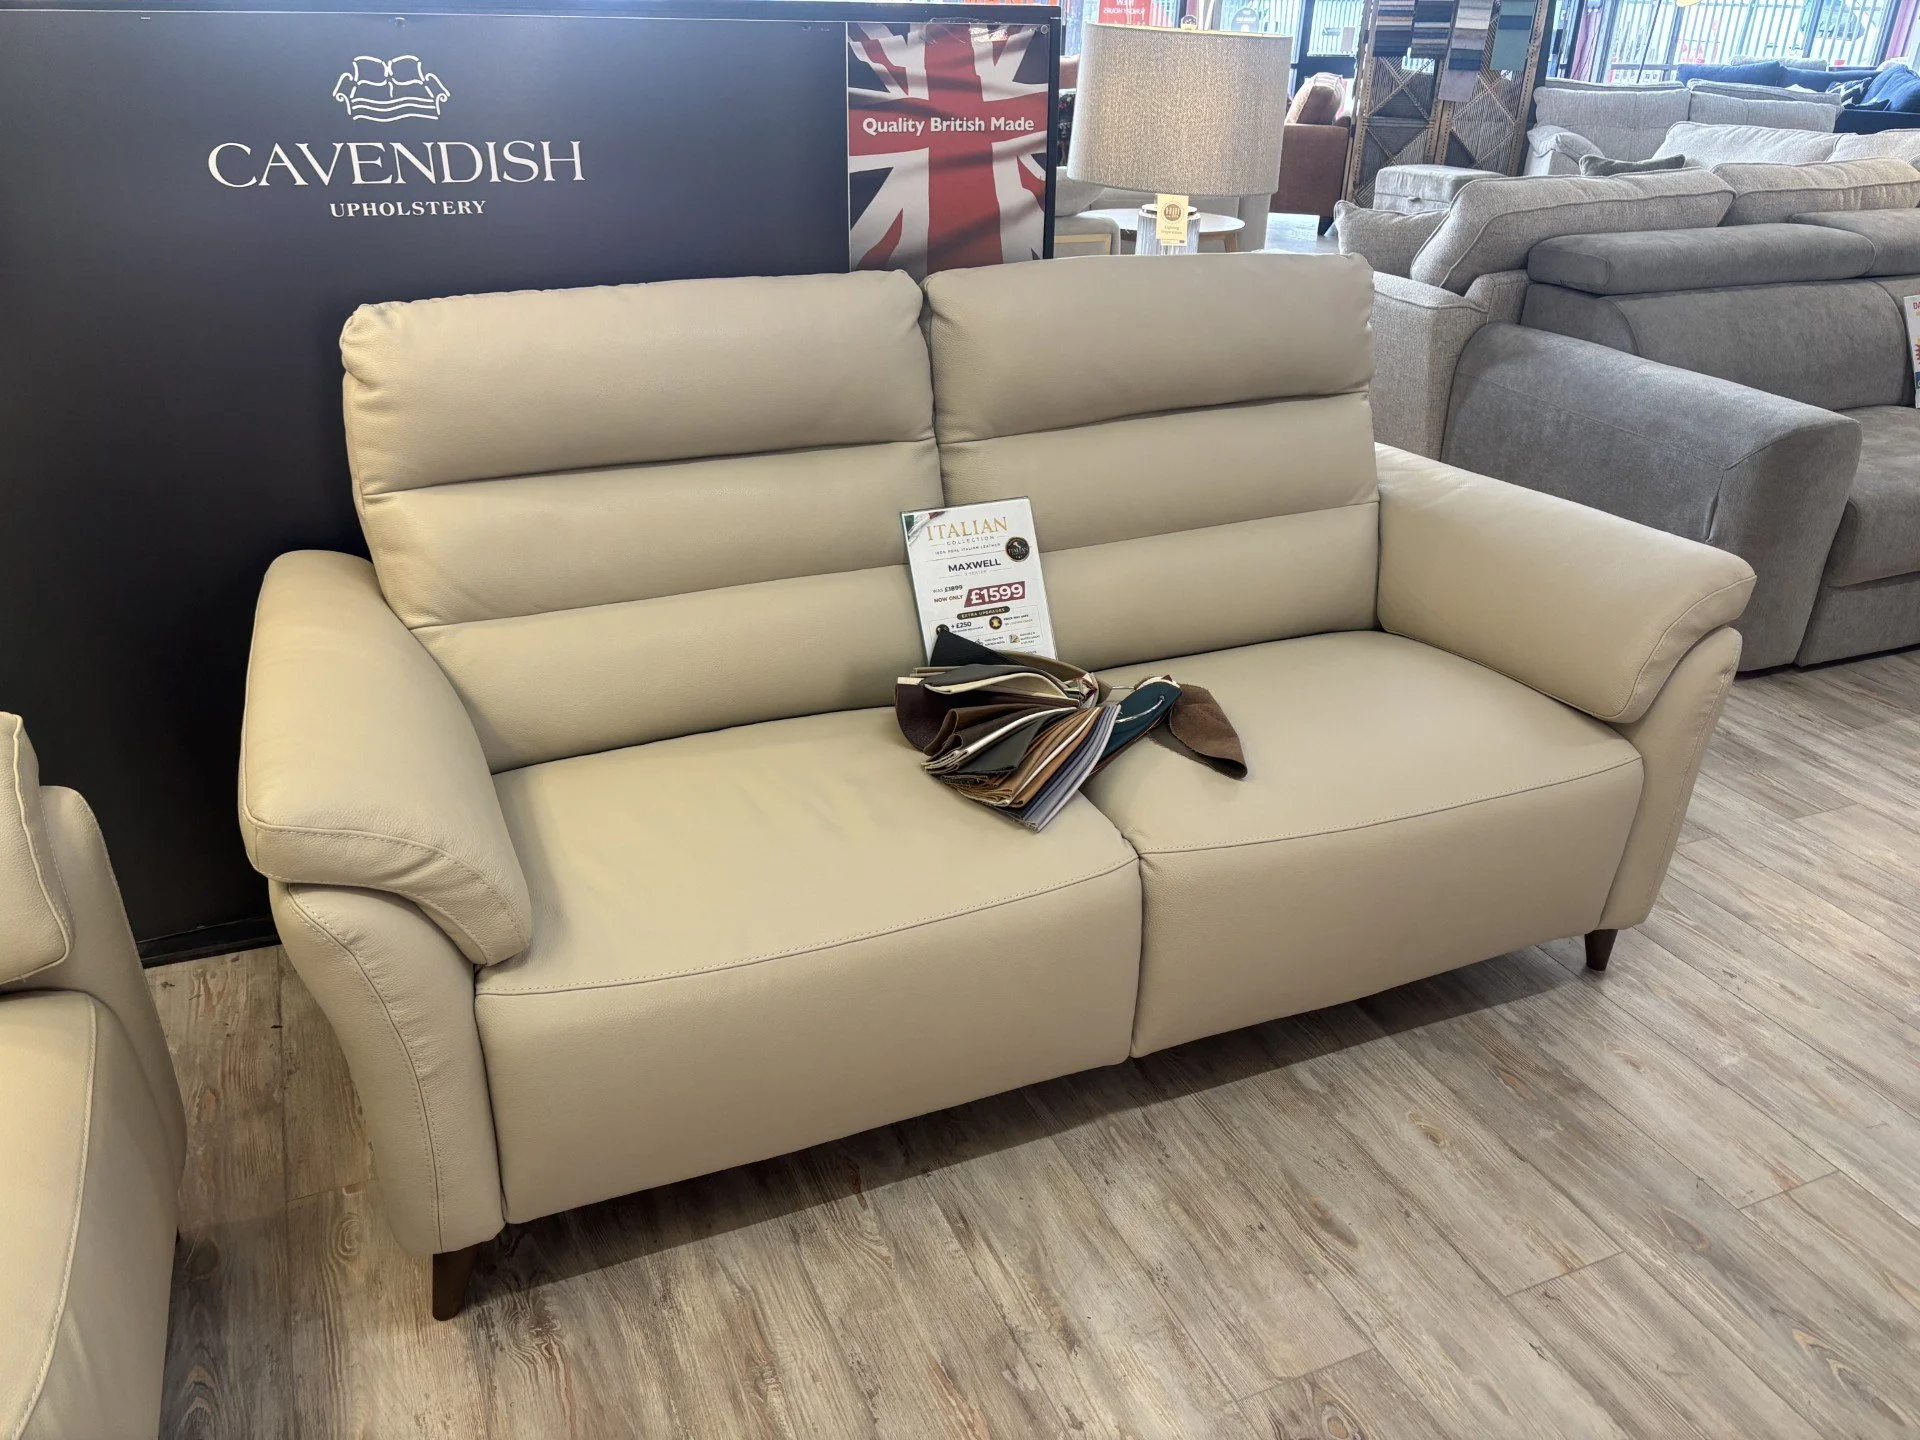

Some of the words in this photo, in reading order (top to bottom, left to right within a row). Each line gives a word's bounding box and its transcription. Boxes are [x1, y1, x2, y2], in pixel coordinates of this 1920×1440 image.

[862, 117, 925, 136] Quality
[930, 117, 985, 132] British
[990, 116, 1035, 131] Made
[208, 140, 585, 188] CAVENDISH
[330, 200, 487, 218] UPHOLSTERY
[926, 516, 1008, 541] ITALIAN
[946, 535, 995, 546] COLLECTION
[948, 558, 1002, 573] MAXWELL
[970, 583, 1024, 604] £1599
